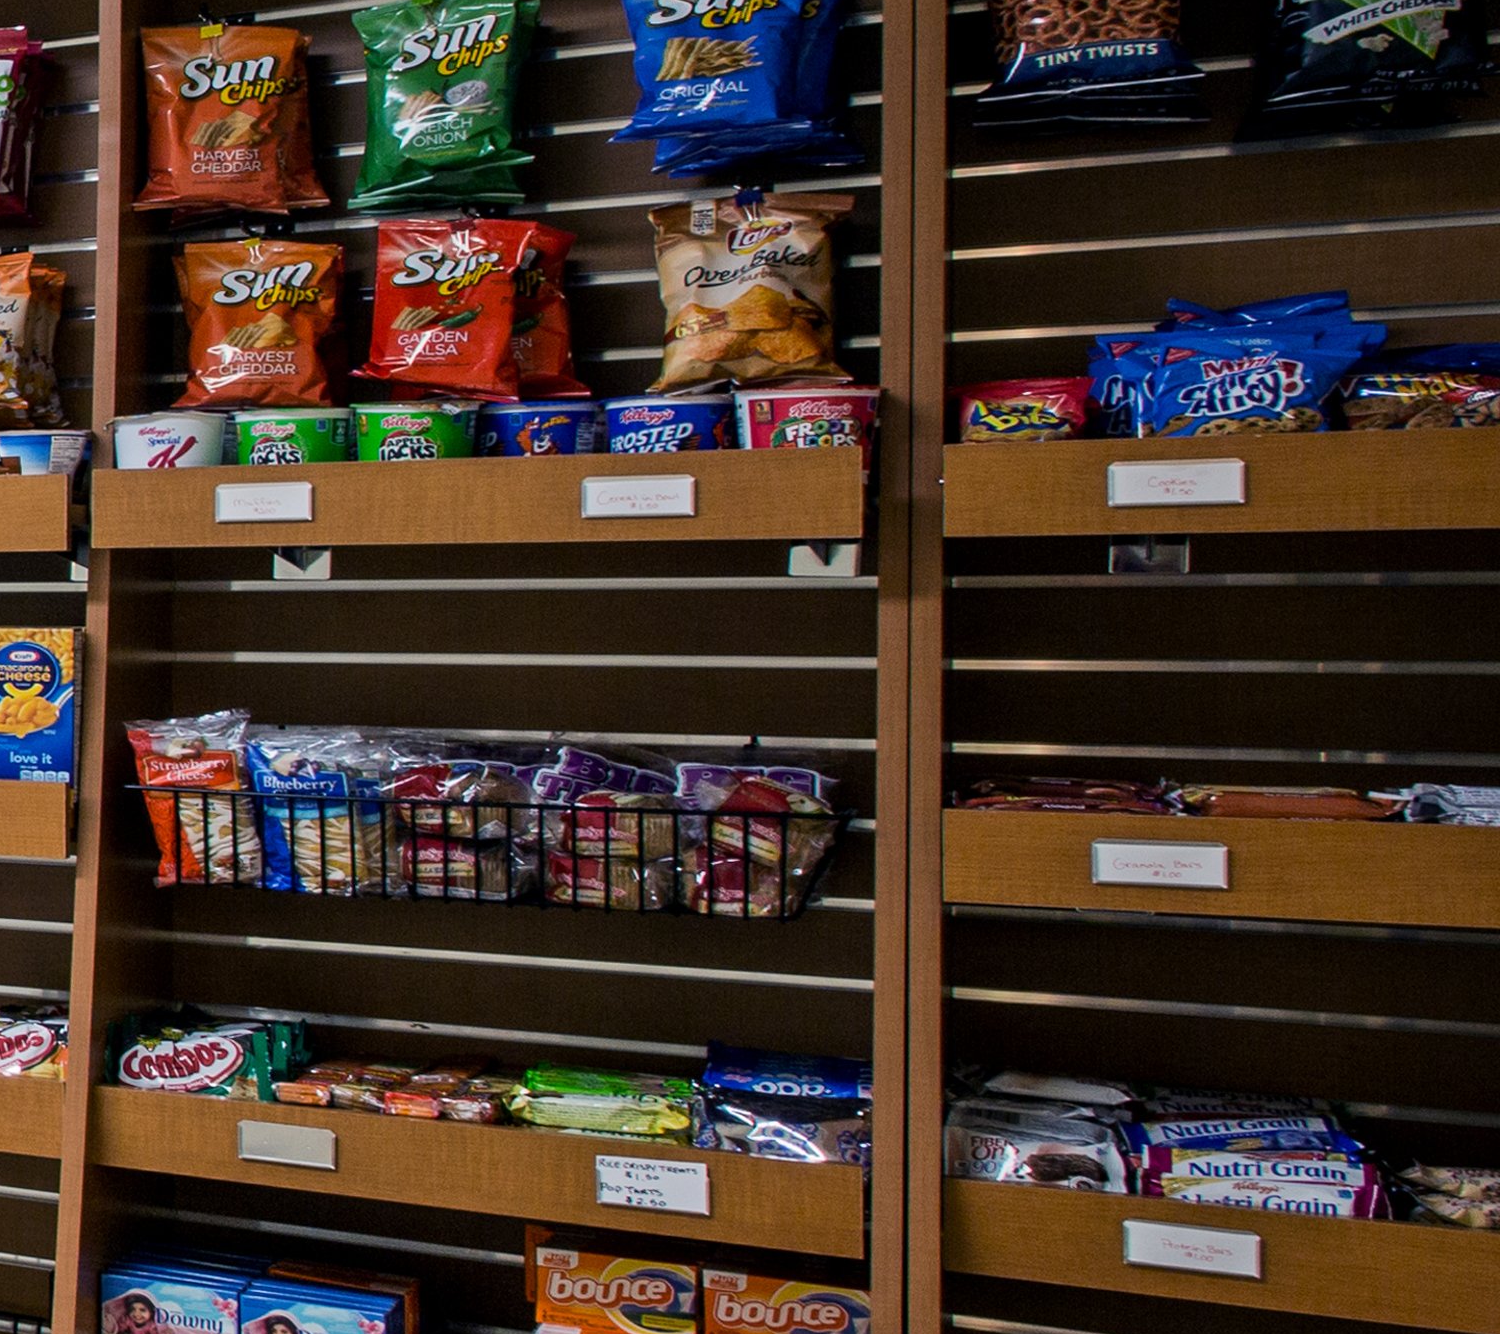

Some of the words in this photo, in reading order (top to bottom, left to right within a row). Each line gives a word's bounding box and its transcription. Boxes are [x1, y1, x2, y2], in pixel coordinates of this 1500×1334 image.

[1323, 8, 1381, 37] WHITE
[390, 13, 498, 73] Sun
[1035, 47, 1083, 68] TINY
[1087, 42, 1159, 60] TWISTS
[179, 53, 276, 101] Sun
[659, 80, 750, 100] ORIGINAL
[412, 130, 468, 147] ONION
[193, 148, 260, 161] HARVEST
[190, 160, 262, 174] CHEDDAR
[211, 259, 314, 307] Sun
[397, 330, 469, 346] GARDEN
[402, 343, 459, 357] SALSA
[218, 363, 297, 376] CHEDDAR
[609, 421, 695, 453] FROSTED
[783, 419, 856, 438] FROOT
[147, 435, 182, 447] Special
[385, 435, 424, 448] APPLE
[797, 434, 860, 449] LOOPS
[147, 435, 197, 468] K
[379, 444, 439, 461] JACKS
[1147, 475, 1198, 489] Cookies
[150, 758, 230, 773] Strawberry
[166, 768, 215, 781] Cheese
[262, 774, 338, 792] Blueberry
[119, 1033, 246, 1089] Combos
[598, 1158, 621, 1169] RICE
[1187, 1160, 1264, 1179] Nutri
[1269, 1161, 1349, 1183] Grain
[624, 1185, 664, 1197] TARTS
[626, 1195, 667, 1208] $2.50
[549, 1270, 665, 1308] bounce
[716, 1293, 841, 1328] bounce
